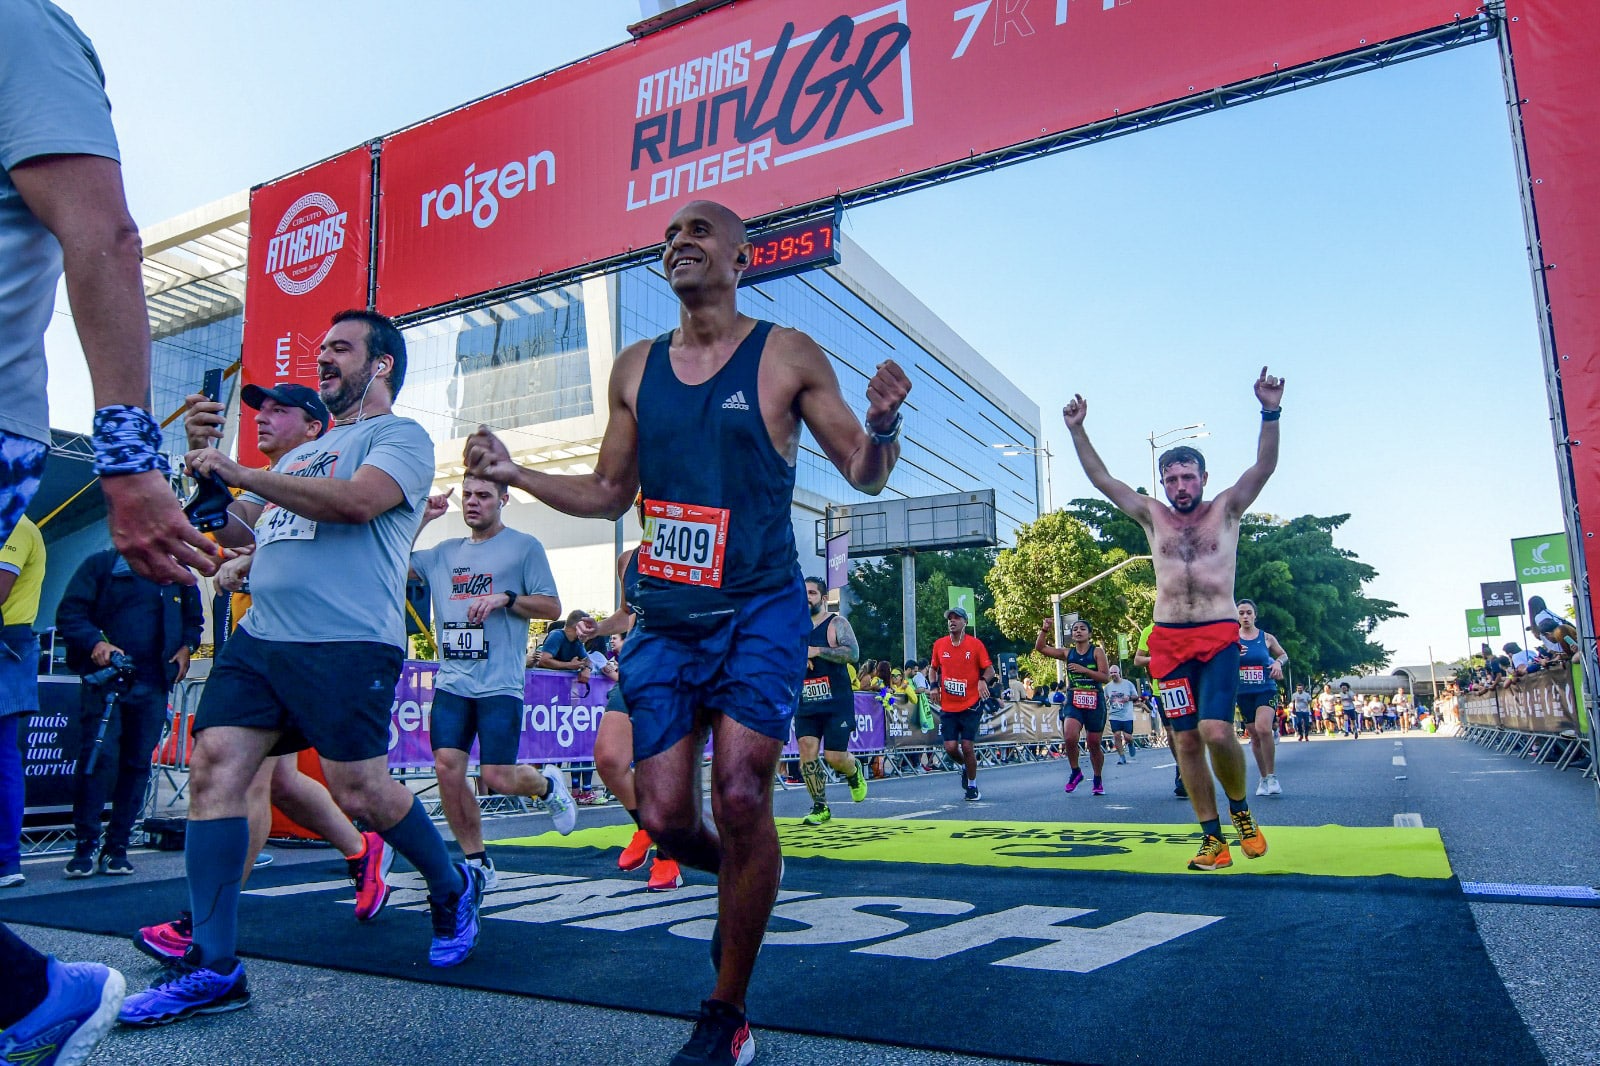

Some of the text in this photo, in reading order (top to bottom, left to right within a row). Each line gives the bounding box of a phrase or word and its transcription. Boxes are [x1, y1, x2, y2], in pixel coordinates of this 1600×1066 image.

[636, 39, 752, 118] ATHENAS
[630, 14, 911, 171] RUN LGR
[626, 138, 772, 211] LONGER
[421, 150, 556, 229] raízen
[292, 210, 322, 227] CIRCUITO
[265, 212, 348, 275] ATHENAS
[721, 401, 750, 411] adidas
[654, 523, 710, 564] 5409
[1522, 563, 1566, 576] cosan
[457, 632, 472, 649] 40
[1244, 671, 1262, 680] 3156
[806, 683, 827, 697] 3010
[1077, 695, 1094, 705] 5963
[28, 712, 69, 728] mais
[27, 732, 58, 748] que
[26, 747, 63, 760] uma
[25, 759, 77, 776] corrid
